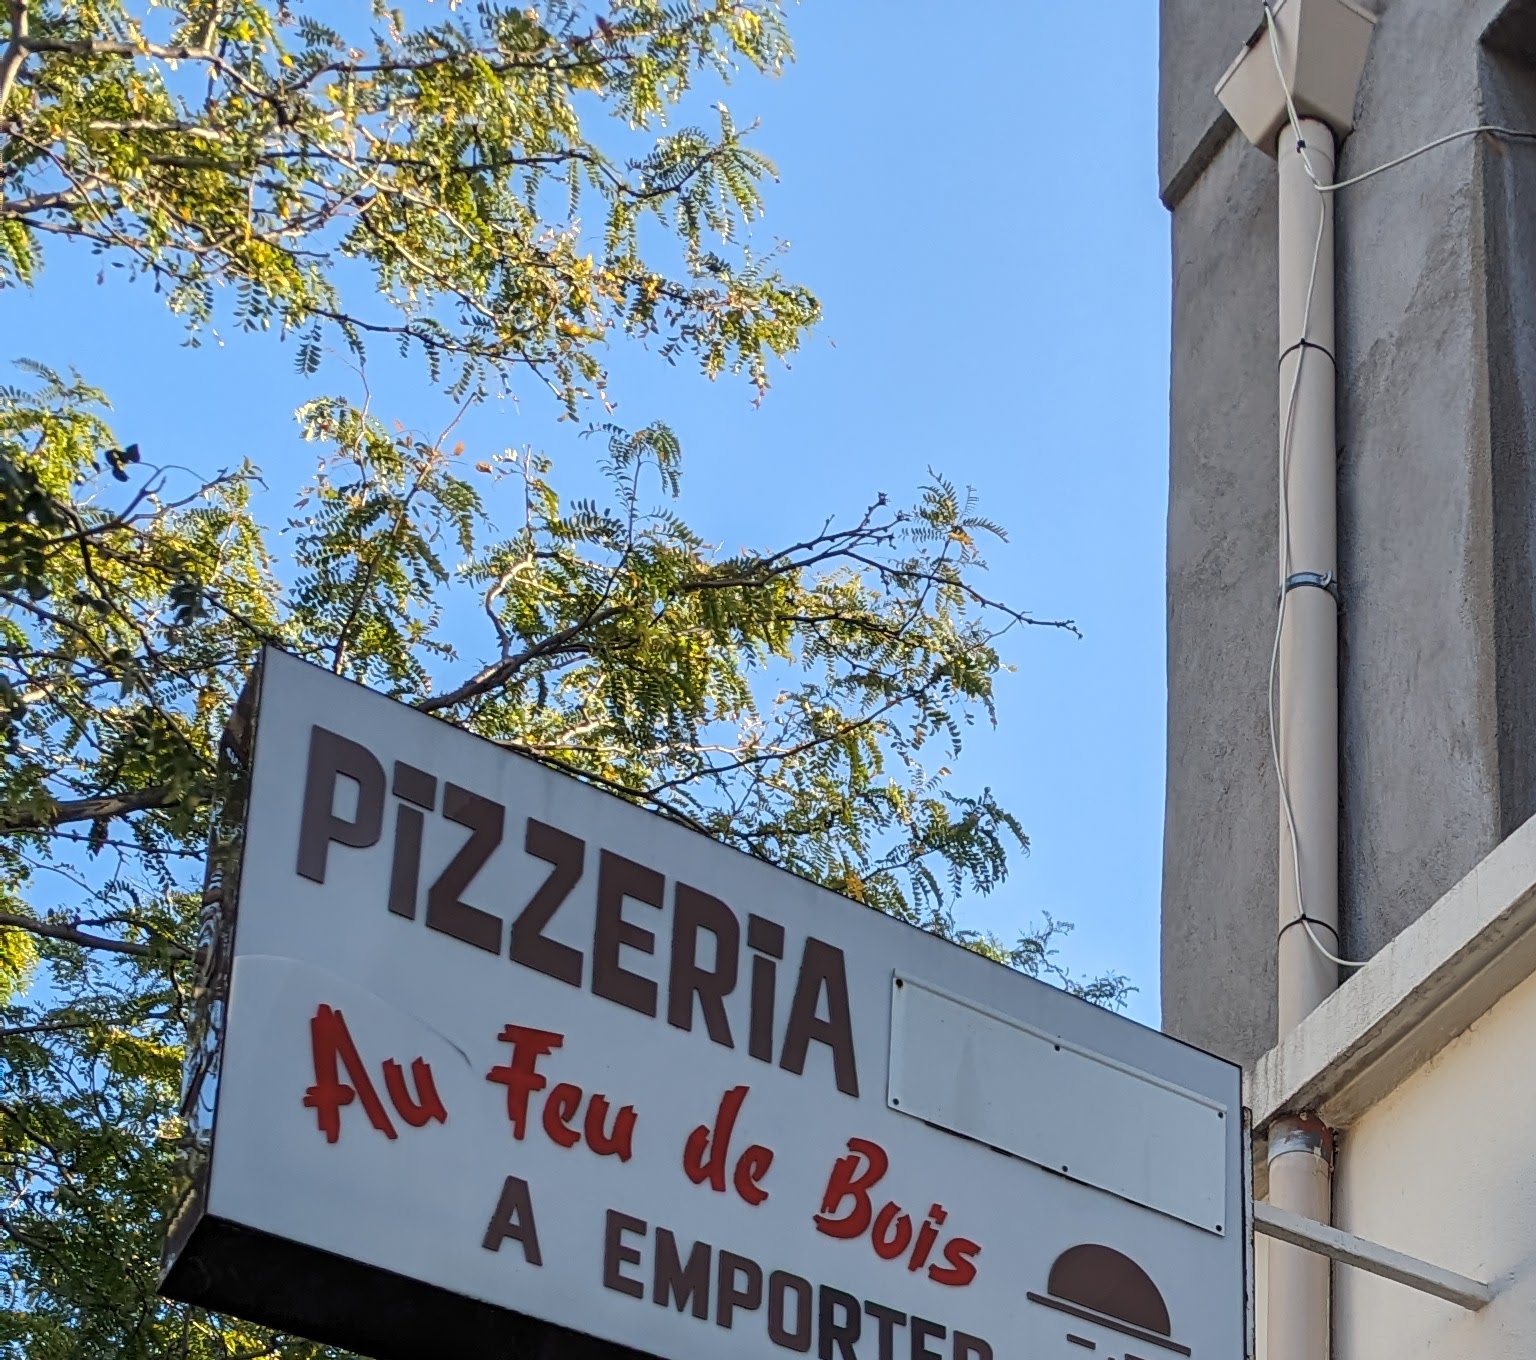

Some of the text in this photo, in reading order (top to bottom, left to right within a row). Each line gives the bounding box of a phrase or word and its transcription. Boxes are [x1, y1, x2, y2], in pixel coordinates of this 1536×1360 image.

[302, 1003, 982, 1288] Au Feu de Bois
[482, 1174, 544, 1267] A
